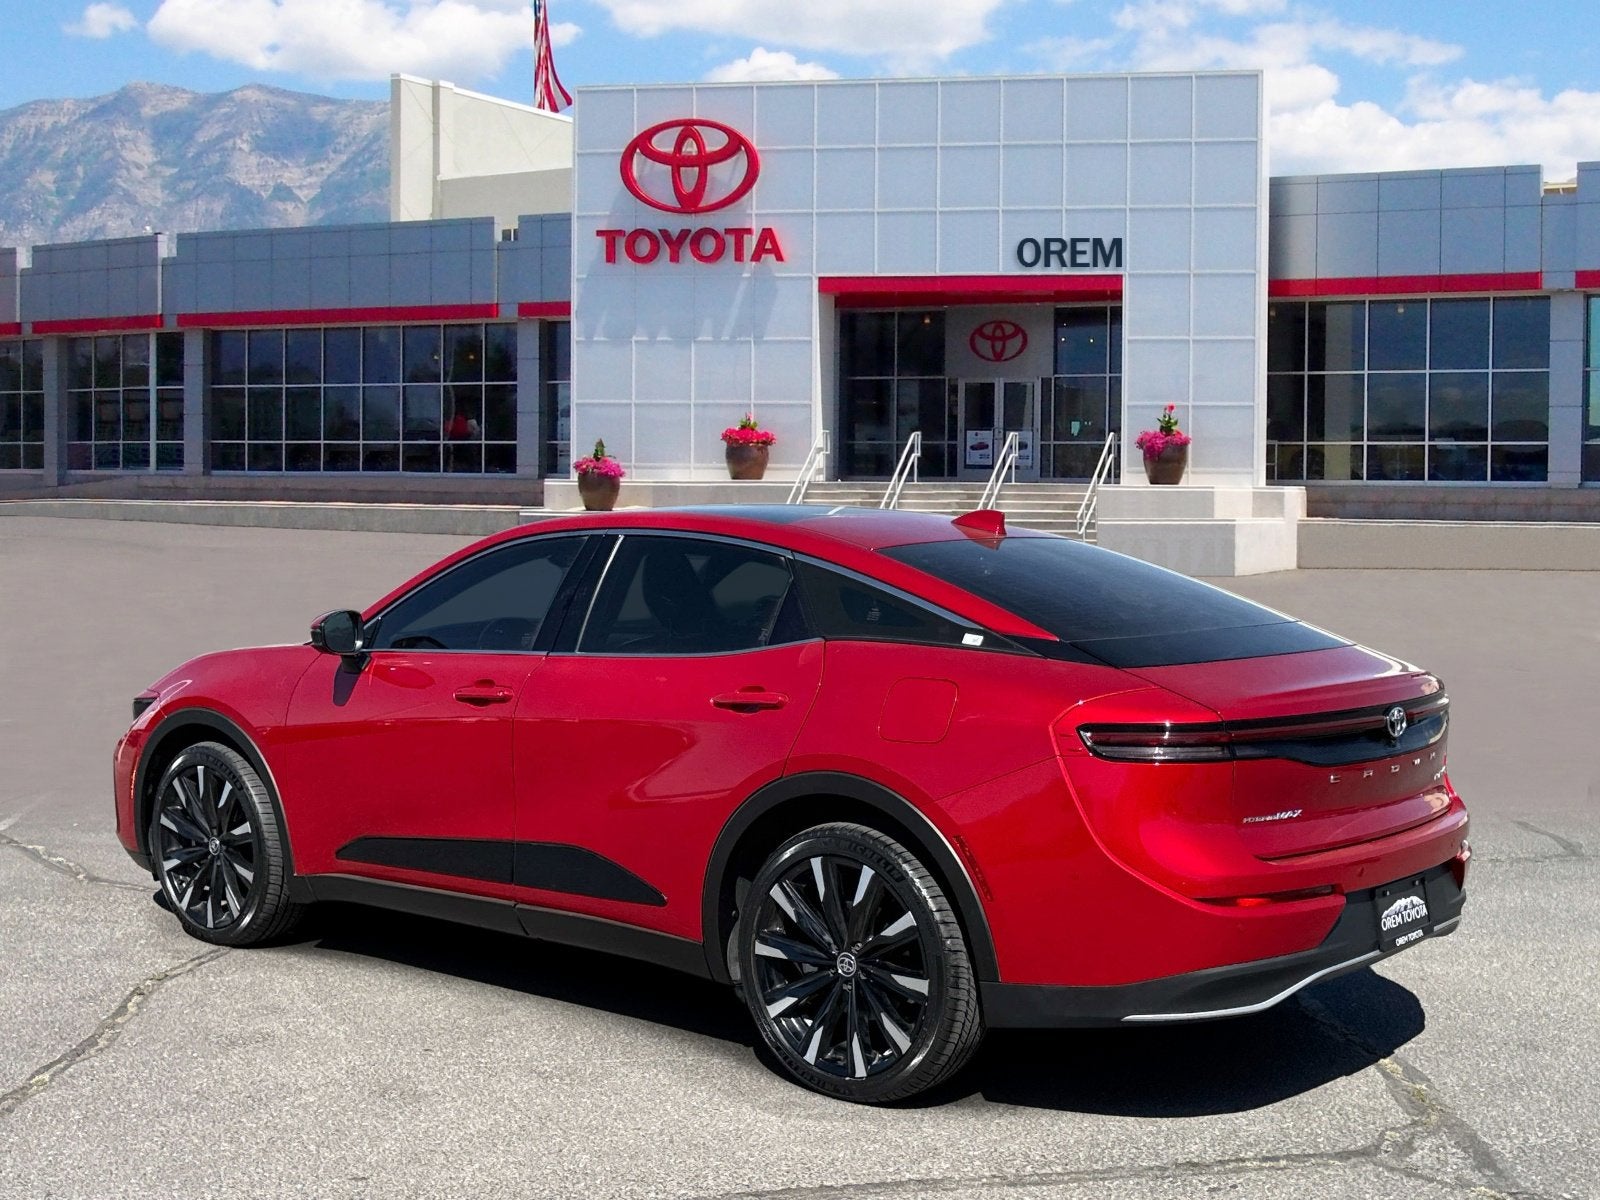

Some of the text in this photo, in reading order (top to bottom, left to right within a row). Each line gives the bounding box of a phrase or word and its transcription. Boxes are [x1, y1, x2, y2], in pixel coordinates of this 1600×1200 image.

[596, 227, 785, 264] TOYOTA
[1017, 237, 1123, 268] OREM
[1381, 904, 1428, 931] OREM TOYOTA
[1395, 935, 1409, 947] OREM
